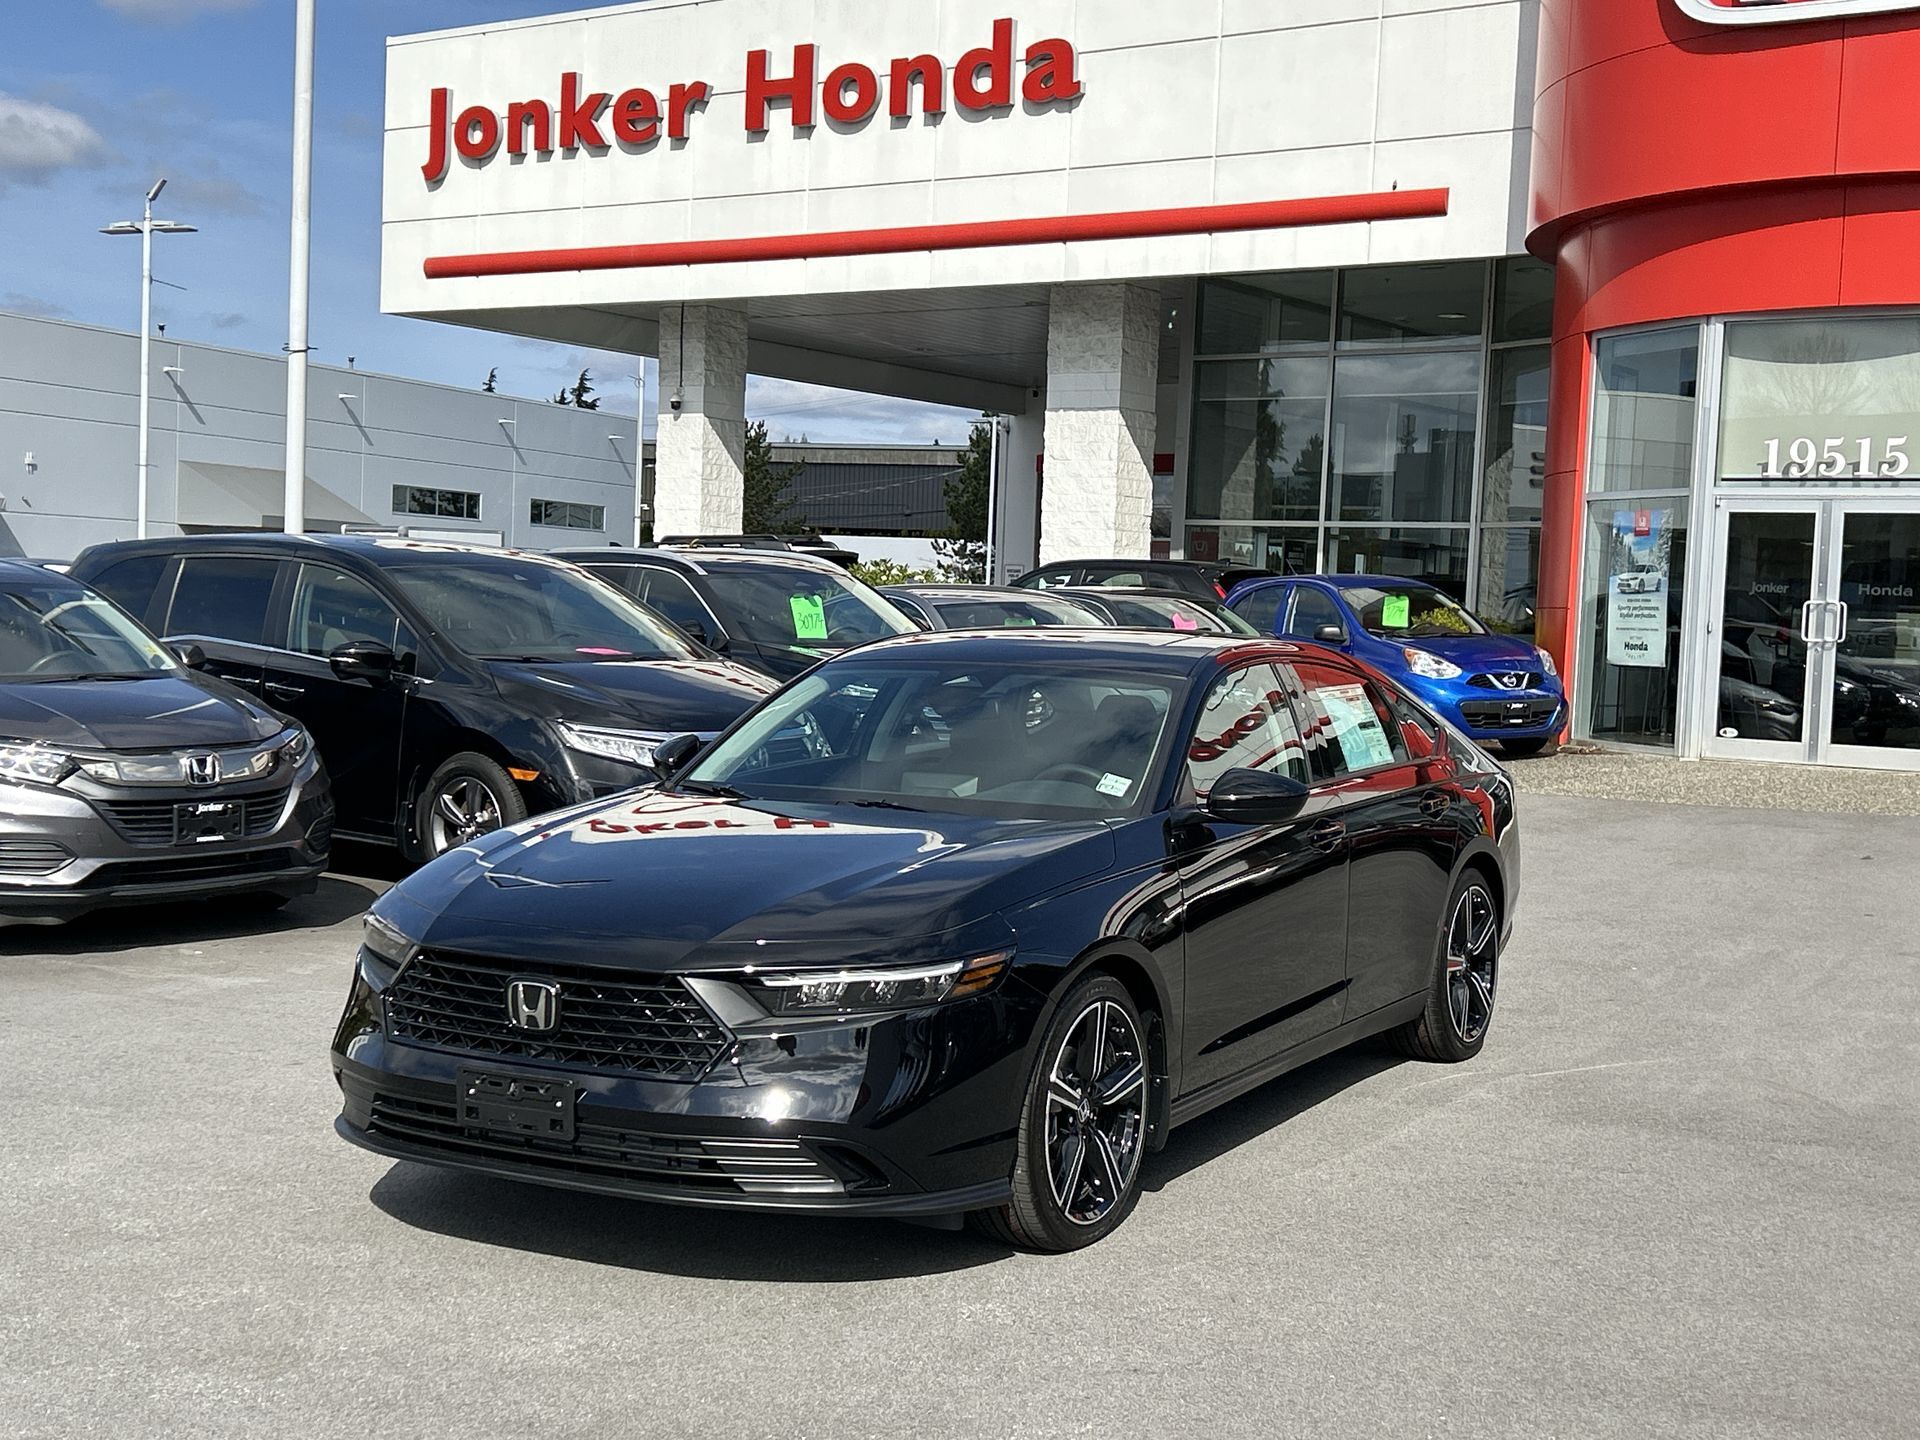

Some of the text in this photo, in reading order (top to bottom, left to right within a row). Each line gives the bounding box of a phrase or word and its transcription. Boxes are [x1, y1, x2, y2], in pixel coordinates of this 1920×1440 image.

[423, 19, 1080, 179] Jonker Honda
[1762, 435, 1910, 477] 19515
[1749, 581, 1913, 597] Jonker Honda
[1624, 641, 1649, 651] Honda
